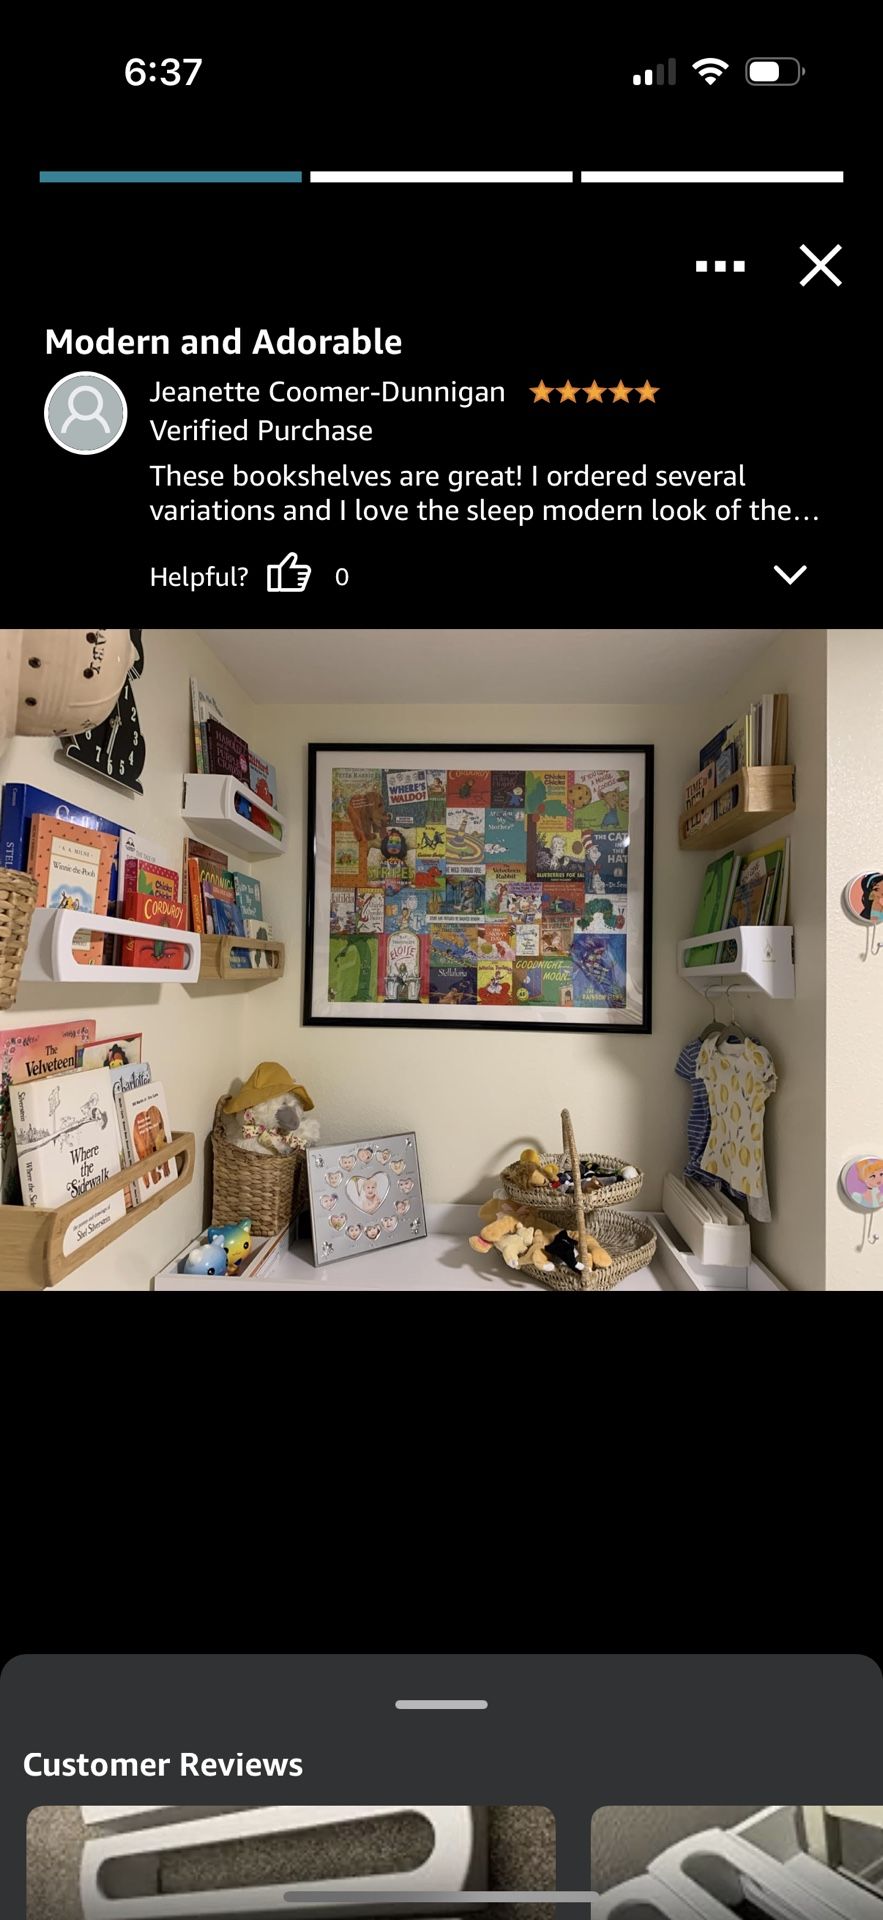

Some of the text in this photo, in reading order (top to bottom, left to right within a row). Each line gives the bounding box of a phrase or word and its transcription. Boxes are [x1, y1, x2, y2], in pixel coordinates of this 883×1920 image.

[125, 58, 202, 86] 6:37
[47, 328, 401, 355] Modern and Adorable
[150, 381, 504, 408] Jeanette Coomer-Dunnigan
[150, 418, 372, 441] Verified Purchase
[150, 464, 223, 486] These
[234, 464, 391, 486] bookshelves
[400, 471, 439, 486] are
[449, 465, 521, 492] great!
[547, 464, 646, 486] ordered
[656, 464, 745, 486] several
[150, 499, 275, 521] variations
[284, 499, 330, 520] and
[356, 499, 408, 521] love
[417, 499, 458, 521] the
[467, 499, 533, 526] sleep
[544, 499, 642, 521] modern
[653, 499, 706, 520] look
[716, 498, 741, 520] of
[150, 566, 248, 592] Helpful?
[336, 568, 348, 586] 0
[131, 706, 136, 722] 2
[133, 731, 139, 746] 3
[95, 745, 101, 762] 7
[128, 750, 134, 766] 4
[119, 760, 125, 775] 5
[389, 782, 426, 795] WHERE'S
[608, 833, 628, 841] CAT
[607, 855, 628, 863] HAT
[144, 898, 184, 927] CORDUROY
[390, 946, 416, 960] ELOISE
[516, 961, 564, 969] GOODNIGHT
[543, 972, 568, 981] MOON
[45, 1044, 58, 1056] The
[25, 1056, 75, 1077] Velveteen
[70, 1145, 99, 1166] Where
[80, 1161, 94, 1177] the
[67, 1167, 109, 1199] Sidewalk
[24, 1753, 302, 1776] Customer Reviews
